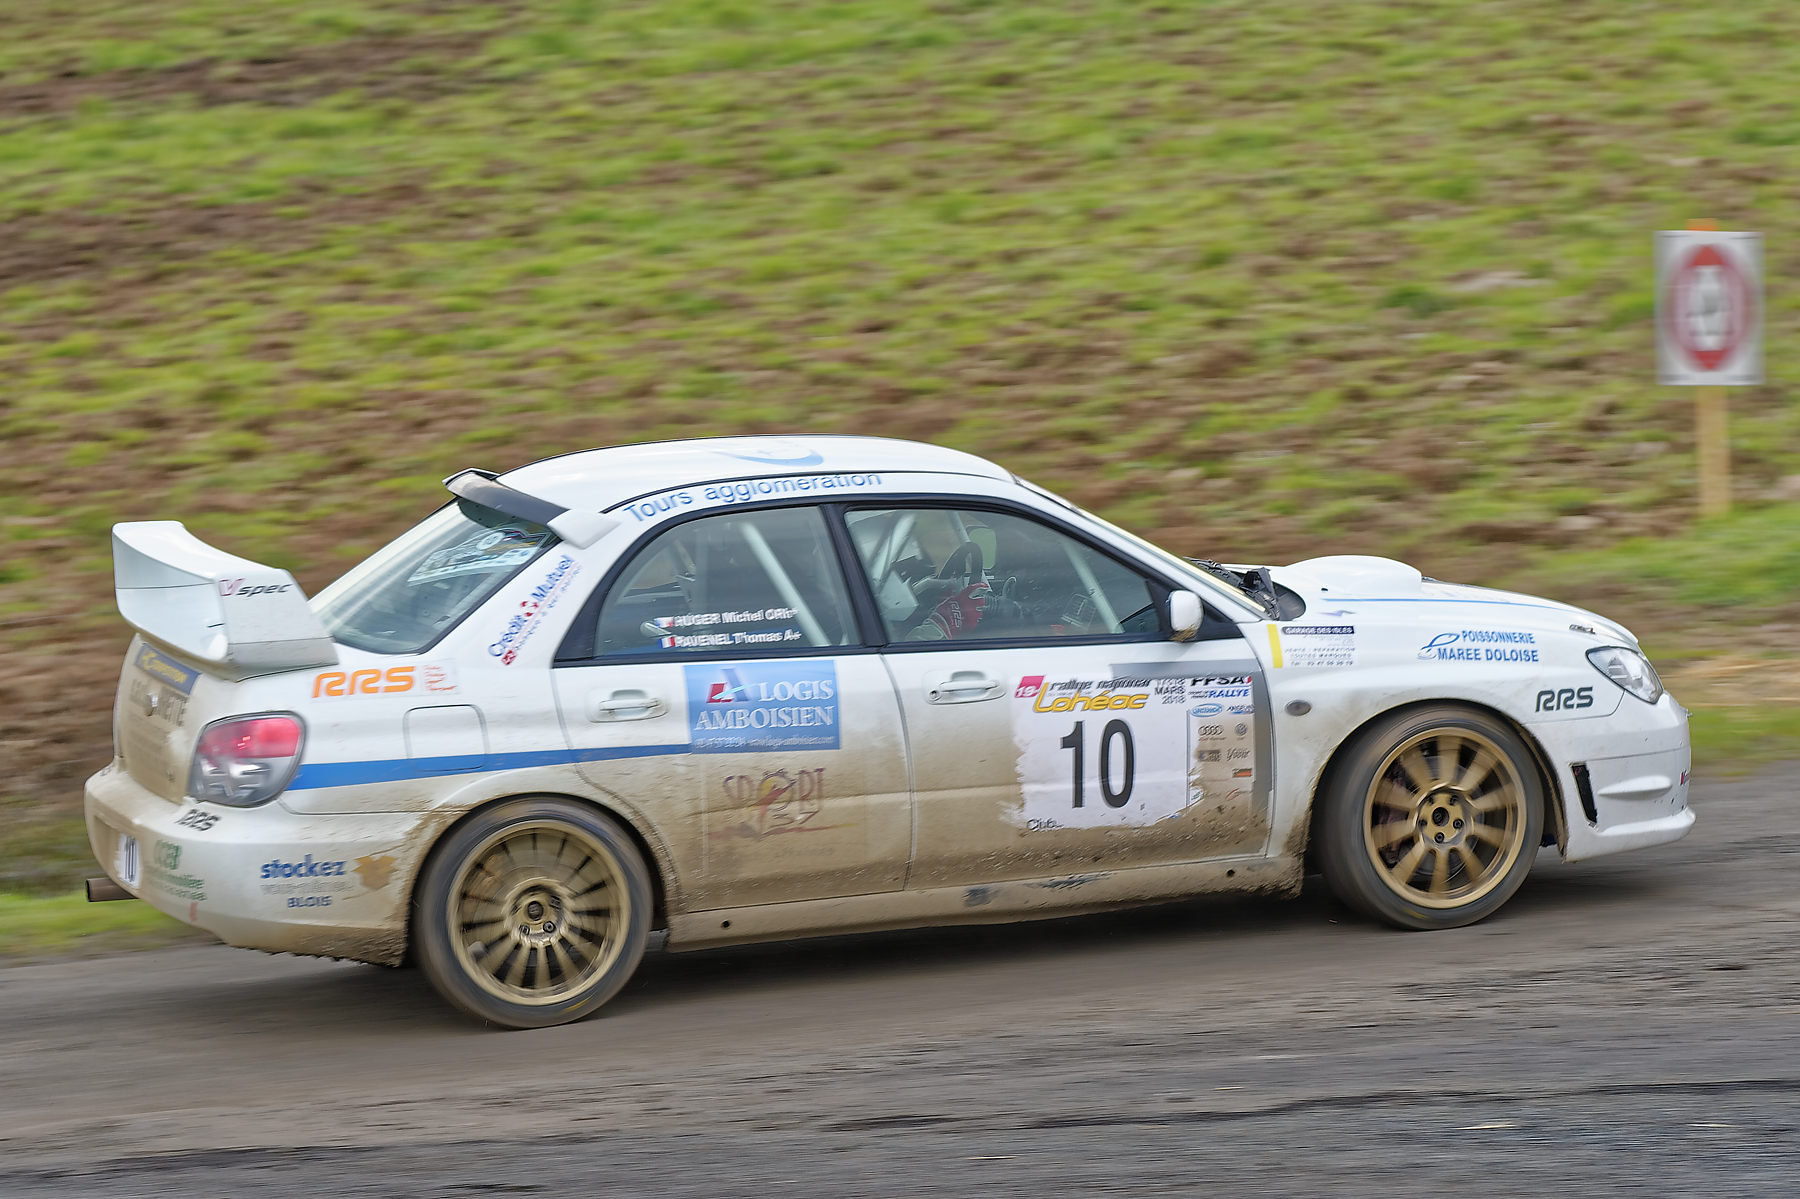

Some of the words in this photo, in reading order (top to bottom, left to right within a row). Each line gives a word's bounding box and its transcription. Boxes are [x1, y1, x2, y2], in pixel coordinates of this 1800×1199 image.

[623, 491, 693, 522] Tours
[704, 473, 882, 503] agglomeration
[530, 555, 576, 602] Mutuel
[721, 609, 764, 624] Michel
[732, 631, 782, 644] Thomas
[1461, 630, 1536, 645] POISSONNERIE
[1437, 647, 1481, 661] MAREE
[1485, 648, 1539, 663] DOLOISE
[312, 666, 415, 698] RRS
[757, 680, 835, 702] LOGIS
[1208, 688, 1249, 698] RALLYE
[1535, 686, 1593, 713] RRS
[694, 705, 836, 731] AMBOISIEN
[1060, 718, 1135, 808] 10
[260, 853, 347, 879] stockez
[287, 895, 333, 909] BLOIS
